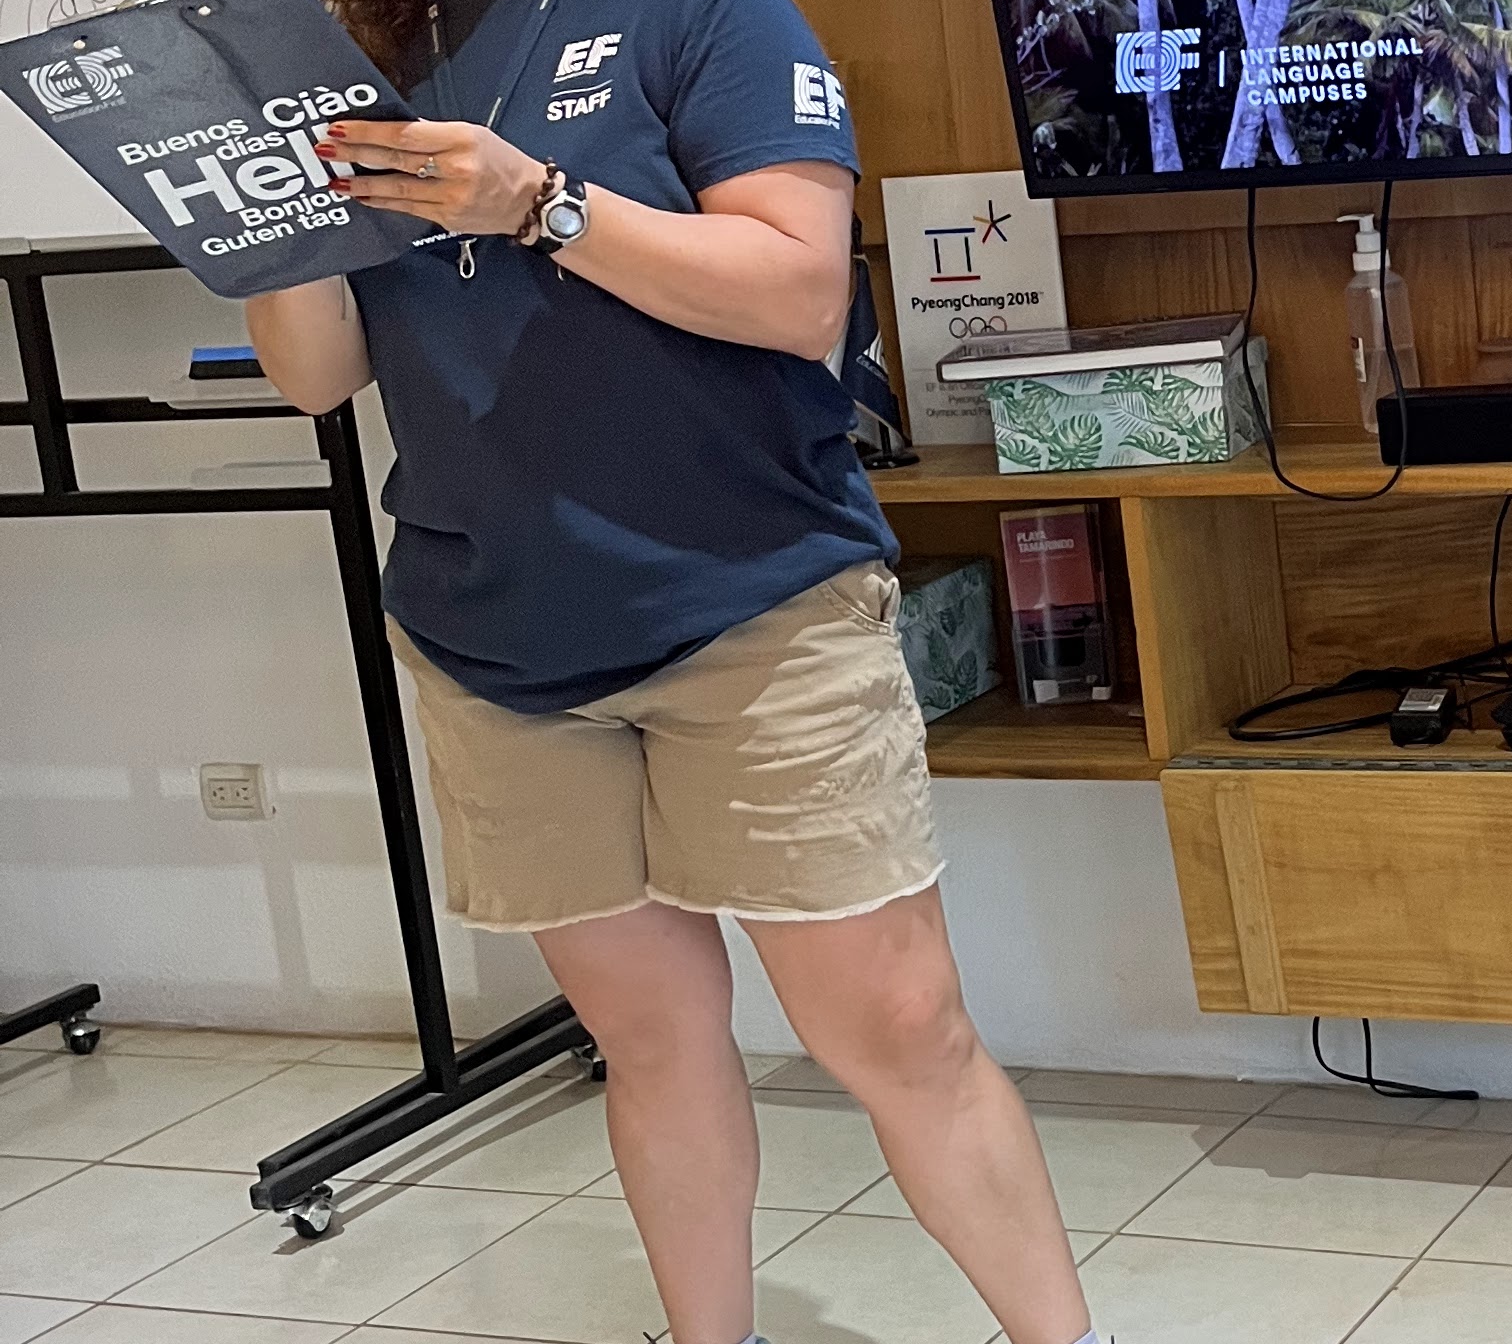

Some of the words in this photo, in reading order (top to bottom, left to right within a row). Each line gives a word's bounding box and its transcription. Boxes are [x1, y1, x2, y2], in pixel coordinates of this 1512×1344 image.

[555, 33, 622, 77] EF
[1115, 28, 1200, 94] EF
[1240, 37, 1424, 66] INTERNATIONAL
[793, 62, 846, 121] EF
[1244, 61, 1366, 86] LANGUAGE
[262, 83, 379, 128] Ciào
[546, 87, 612, 121] STAFF
[1247, 83, 1368, 106] CAMPUSES
[117, 118, 249, 166] Buenos
[216, 131, 287, 161] días
[144, 122, 356, 227] Hell
[239, 190, 351, 228] Bonjou
[201, 221, 296, 256] Guten
[297, 206, 351, 231] tag
[911, 293, 1005, 313] PyeongChang
[1006, 291, 1040, 307] 2018
